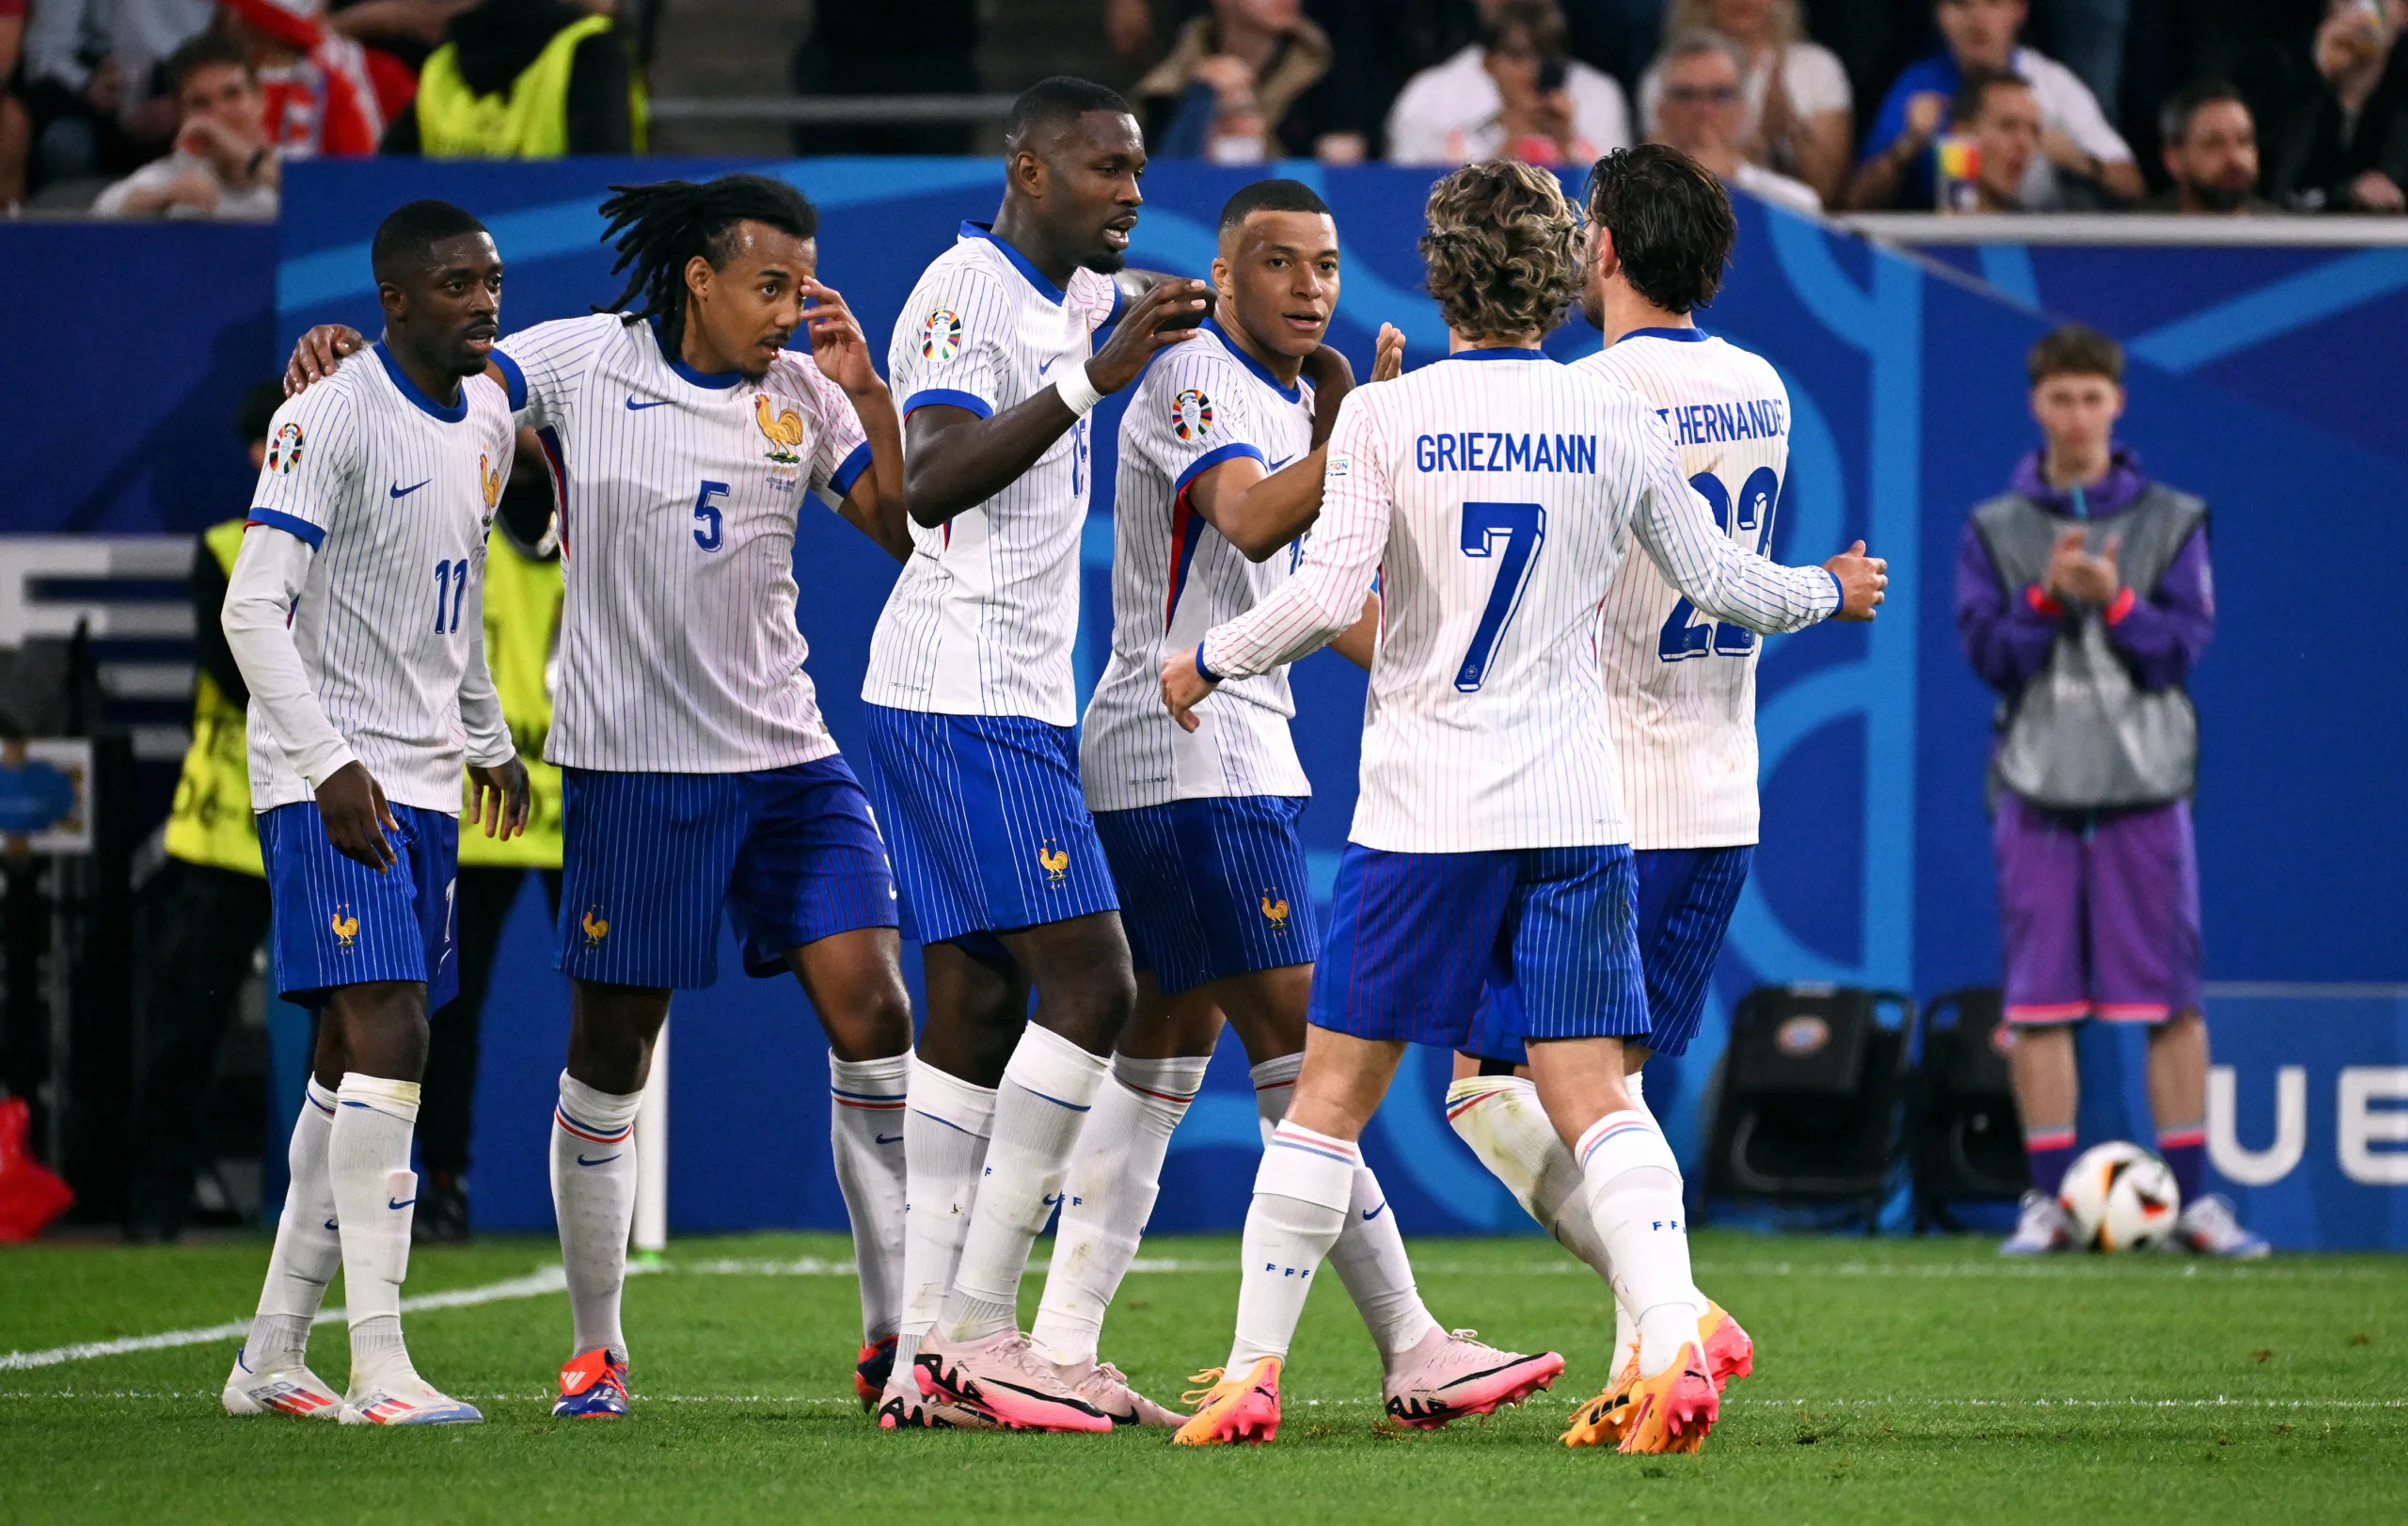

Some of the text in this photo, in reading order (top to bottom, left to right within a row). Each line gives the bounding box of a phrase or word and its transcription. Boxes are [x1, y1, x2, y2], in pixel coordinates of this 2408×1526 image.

[1417, 432, 1596, 474] GRIEZMANN
[693, 480, 731, 552] 5
[436, 559, 468, 634] 11
[1454, 501, 1546, 692] 7
